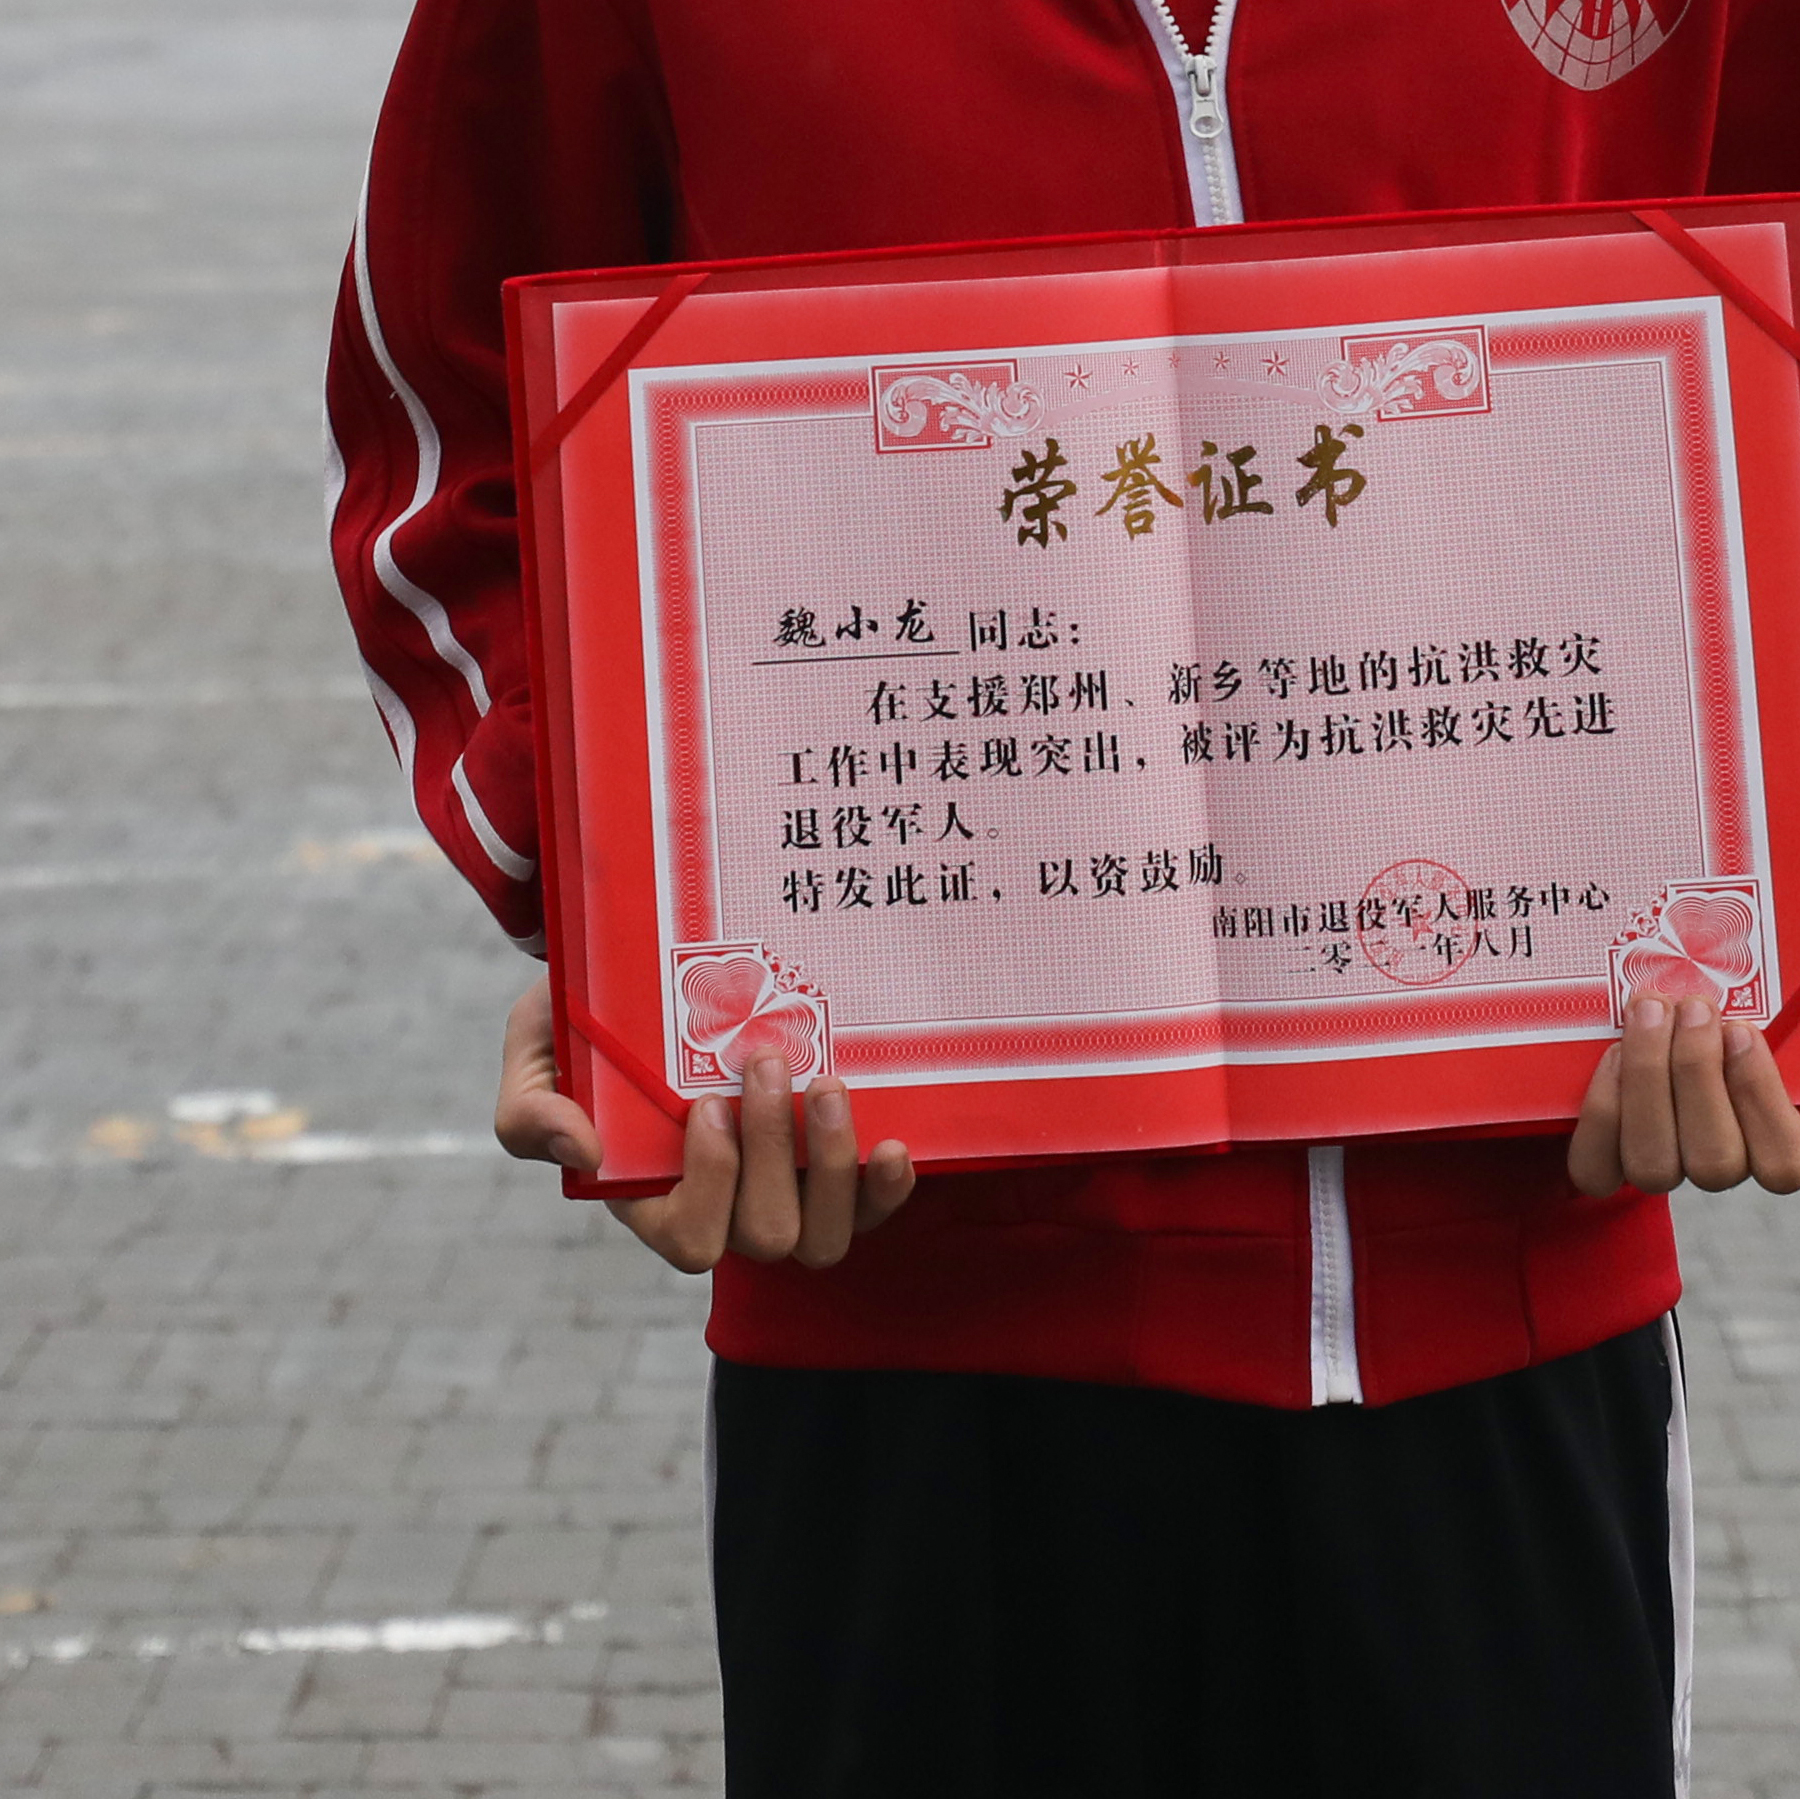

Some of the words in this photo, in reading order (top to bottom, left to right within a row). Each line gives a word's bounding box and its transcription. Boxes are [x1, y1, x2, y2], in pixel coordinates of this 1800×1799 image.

[997, 423, 1368, 549] 荣誉证书
[772, 598, 935, 648] 魏小龙
[865, 632, 1603, 725] 在支援郑州、新乡等地的抗洪救灾
[778, 691, 1617, 789] 工作中表现突出，被评为抗洪救灾先进
[781, 801, 1000, 850] 退役军人。
[781, 842, 1247, 913] 特发此证，以资鼓励。
[1211, 881, 1611, 939] 南阳市退役军人服务中心
[1287, 924, 1535, 974] 二零二一年八月
